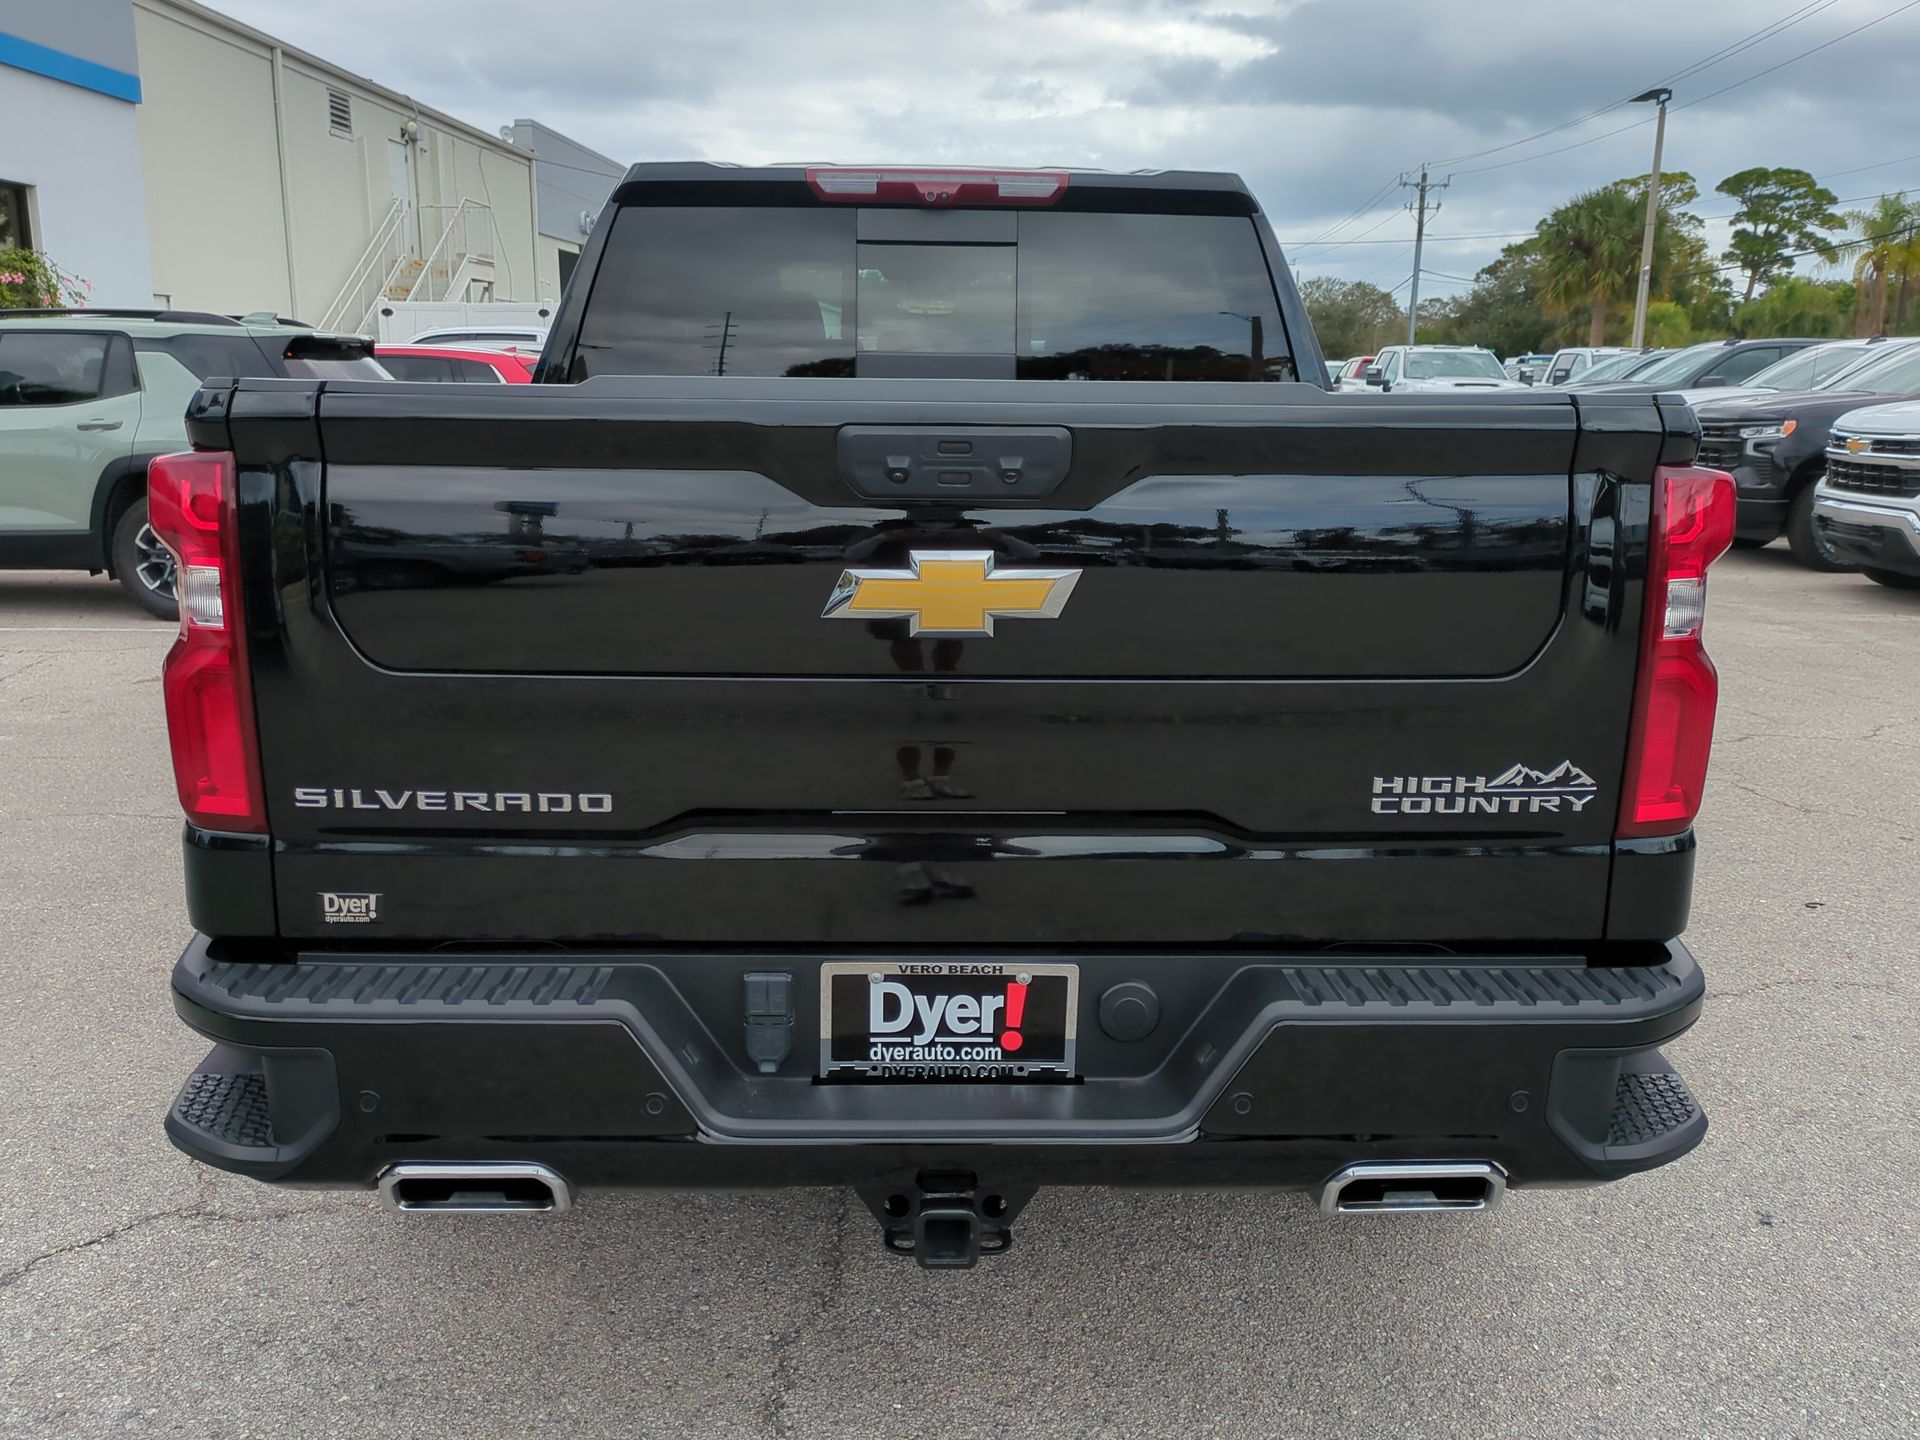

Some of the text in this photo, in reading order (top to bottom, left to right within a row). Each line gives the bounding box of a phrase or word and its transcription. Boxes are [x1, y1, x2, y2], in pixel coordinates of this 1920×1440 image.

[1372, 776, 1486, 794] HIGH
[294, 787, 613, 813] SILVERADO
[1371, 795, 1595, 814] COUNTRY
[323, 893, 377, 919] Dyer!
[325, 915, 370, 923] dyerauto.com
[898, 964, 1003, 975] VERO BEACH
[870, 981, 1028, 1051] Dyer!
[869, 1043, 1002, 1061] dyerauto.com
